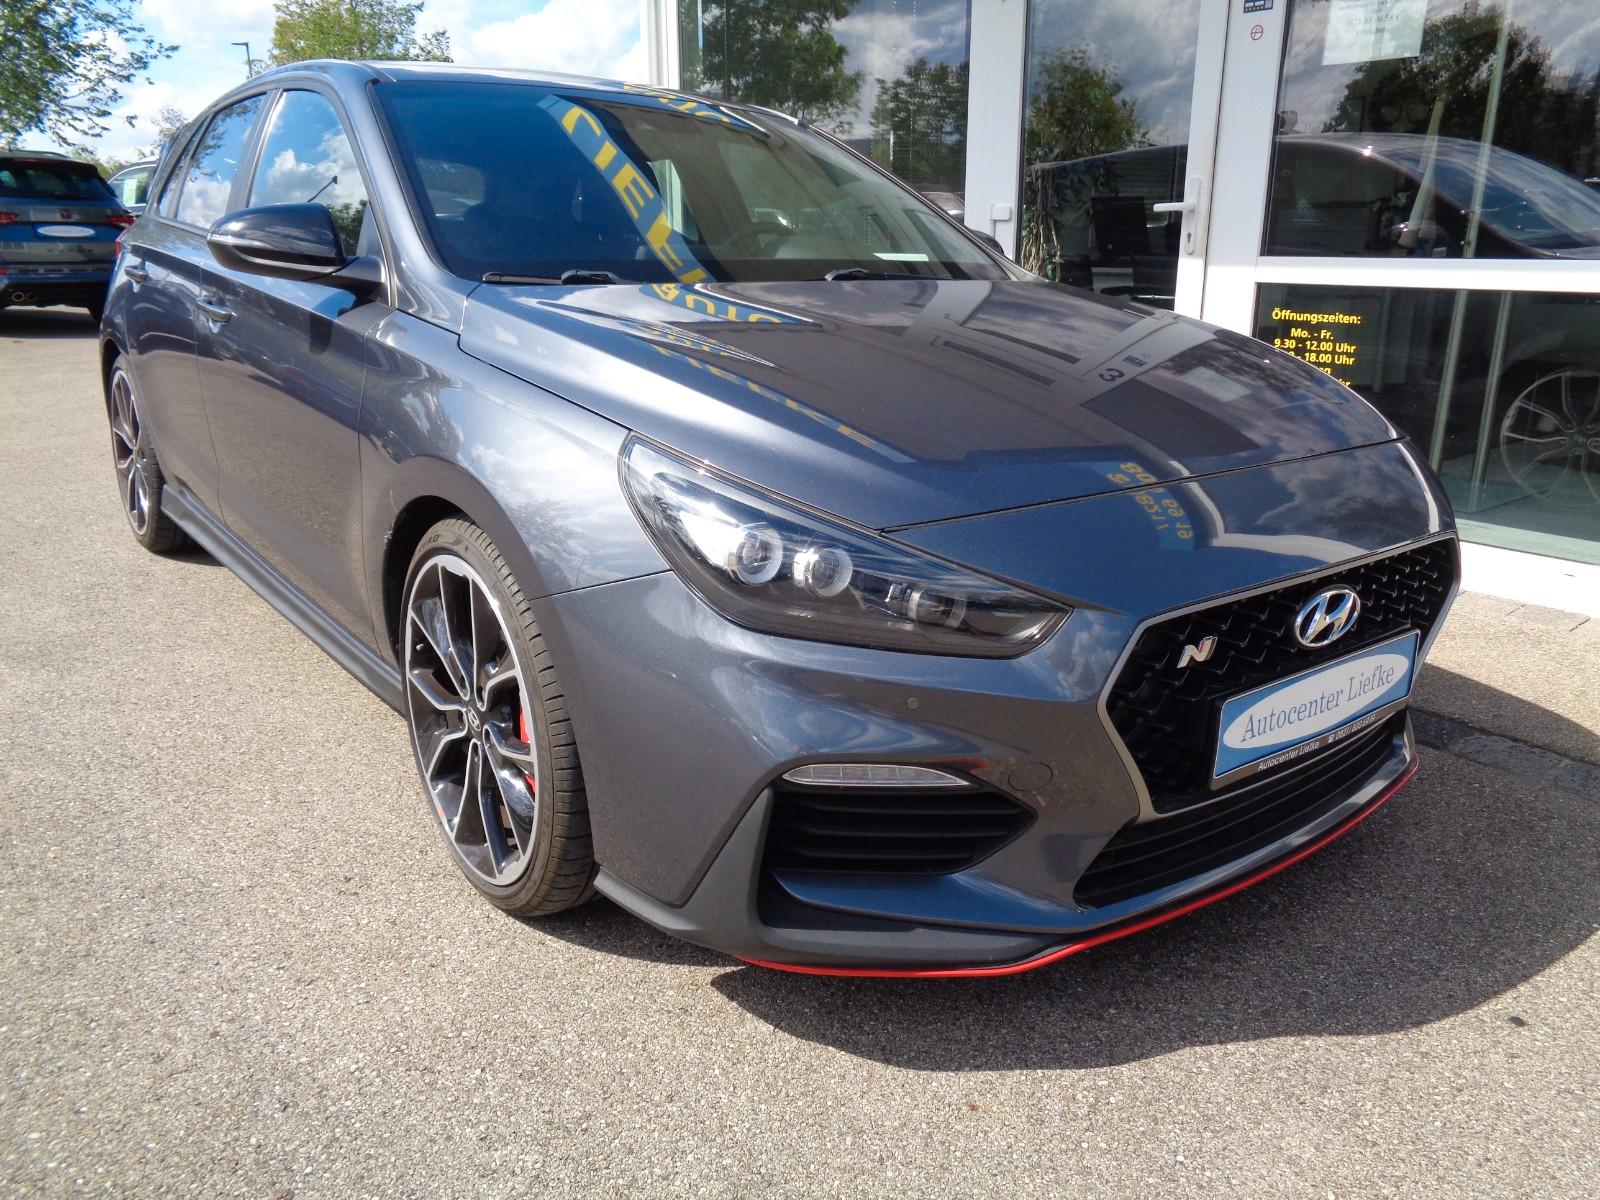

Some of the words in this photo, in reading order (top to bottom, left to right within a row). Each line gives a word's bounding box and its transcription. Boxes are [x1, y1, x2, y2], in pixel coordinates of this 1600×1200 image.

[1271, 307, 1362, 325] Öffnungszeiten:
[1290, 327, 1311, 339] Mo.
[1320, 329, 1334, 340] Fr.
[1274, 338, 1296, 349] 9.30
[1305, 340, 1333, 352] 12.00
[1335, 342, 1357, 353] Uhr
[1304, 352, 1332, 364] 18.00
[1334, 354, 1356, 365] Uhr
[1240, 688, 1344, 743] Autocenter
[1346, 664, 1395, 702] Liefke
[1257, 746, 1300, 772] Autocenter
